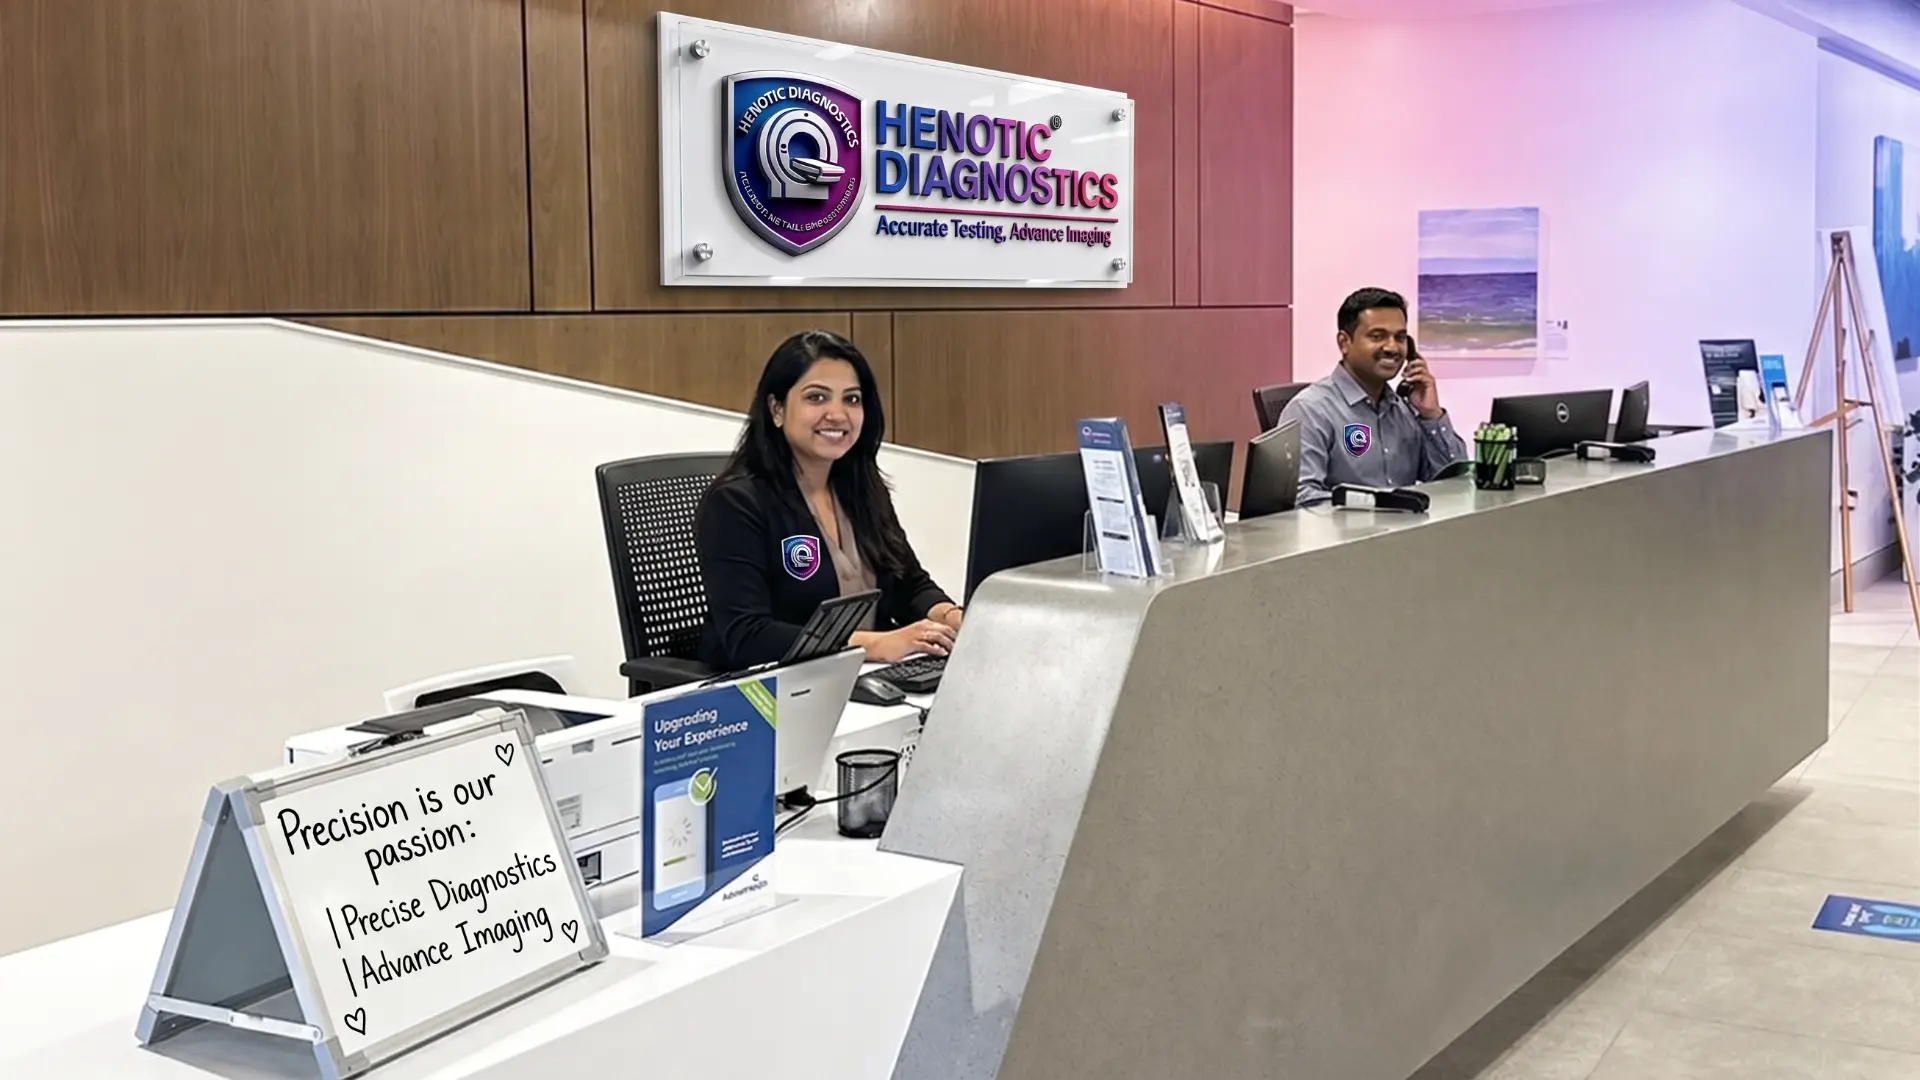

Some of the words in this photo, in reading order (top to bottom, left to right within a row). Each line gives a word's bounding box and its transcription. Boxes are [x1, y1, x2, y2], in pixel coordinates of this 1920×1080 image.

[738, 87, 787, 134] HENOTIC
[789, 86, 859, 148] DIAGNOSTICS
[876, 149, 1118, 210] DIAGNOSTICS
[876, 215, 948, 237] Accurate
[951, 219, 1006, 244] Testing,
[1010, 222, 1064, 243] Advance
[1066, 225, 1111, 247] Imaging
[654, 736, 682, 752] Your
[684, 720, 749, 746] Experience
[278, 801, 409, 856] Precision
[416, 787, 443, 816] is
[454, 773, 496, 806] our
[365, 819, 476, 886] passion:
[341, 896, 425, 941] Precise
[428, 852, 557, 914] Diagnostics
[362, 942, 453, 990] Advance
[456, 907, 554, 955] Imaging
